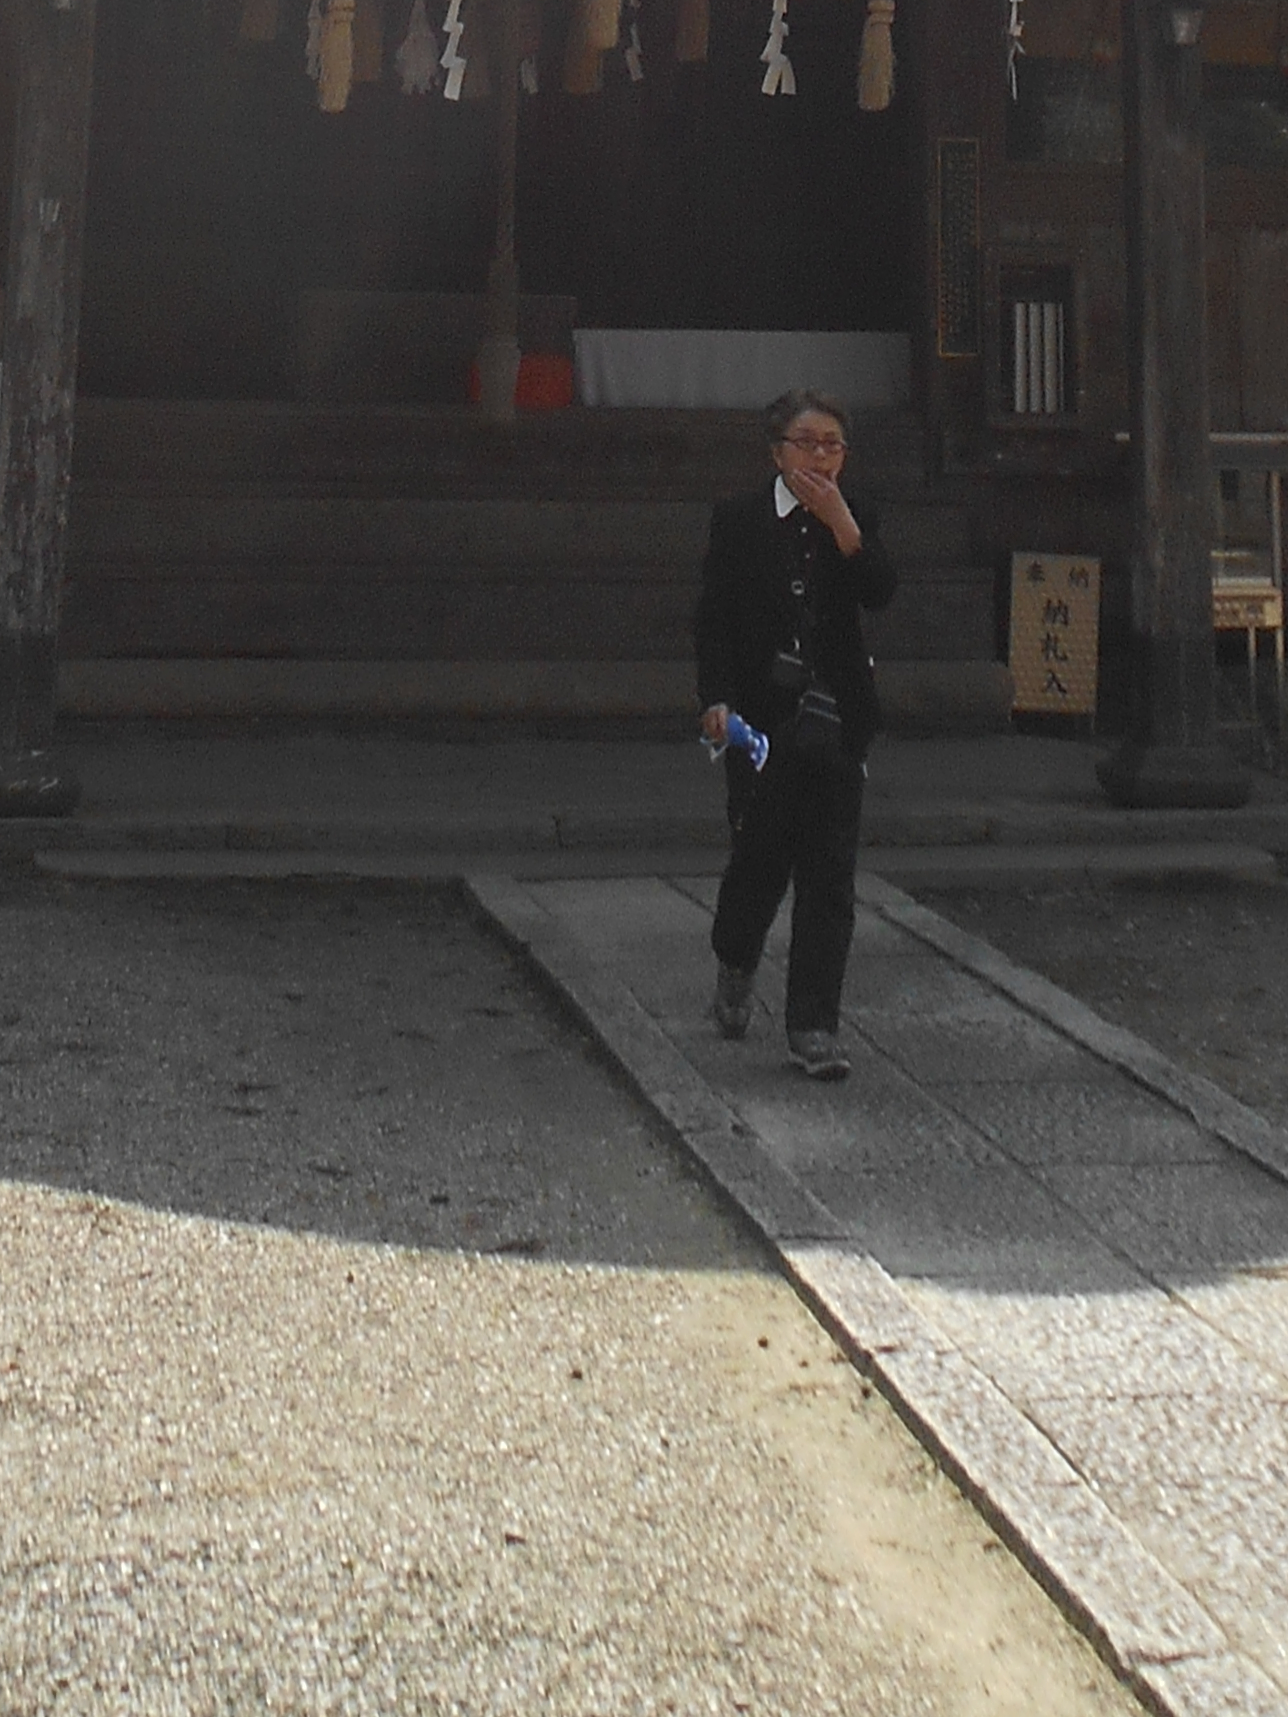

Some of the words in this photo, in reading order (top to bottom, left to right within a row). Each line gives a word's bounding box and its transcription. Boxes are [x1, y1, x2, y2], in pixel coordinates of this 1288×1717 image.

[1026, 560, 1090, 588] 奉納
[1040, 597, 1070, 696] 納札入
